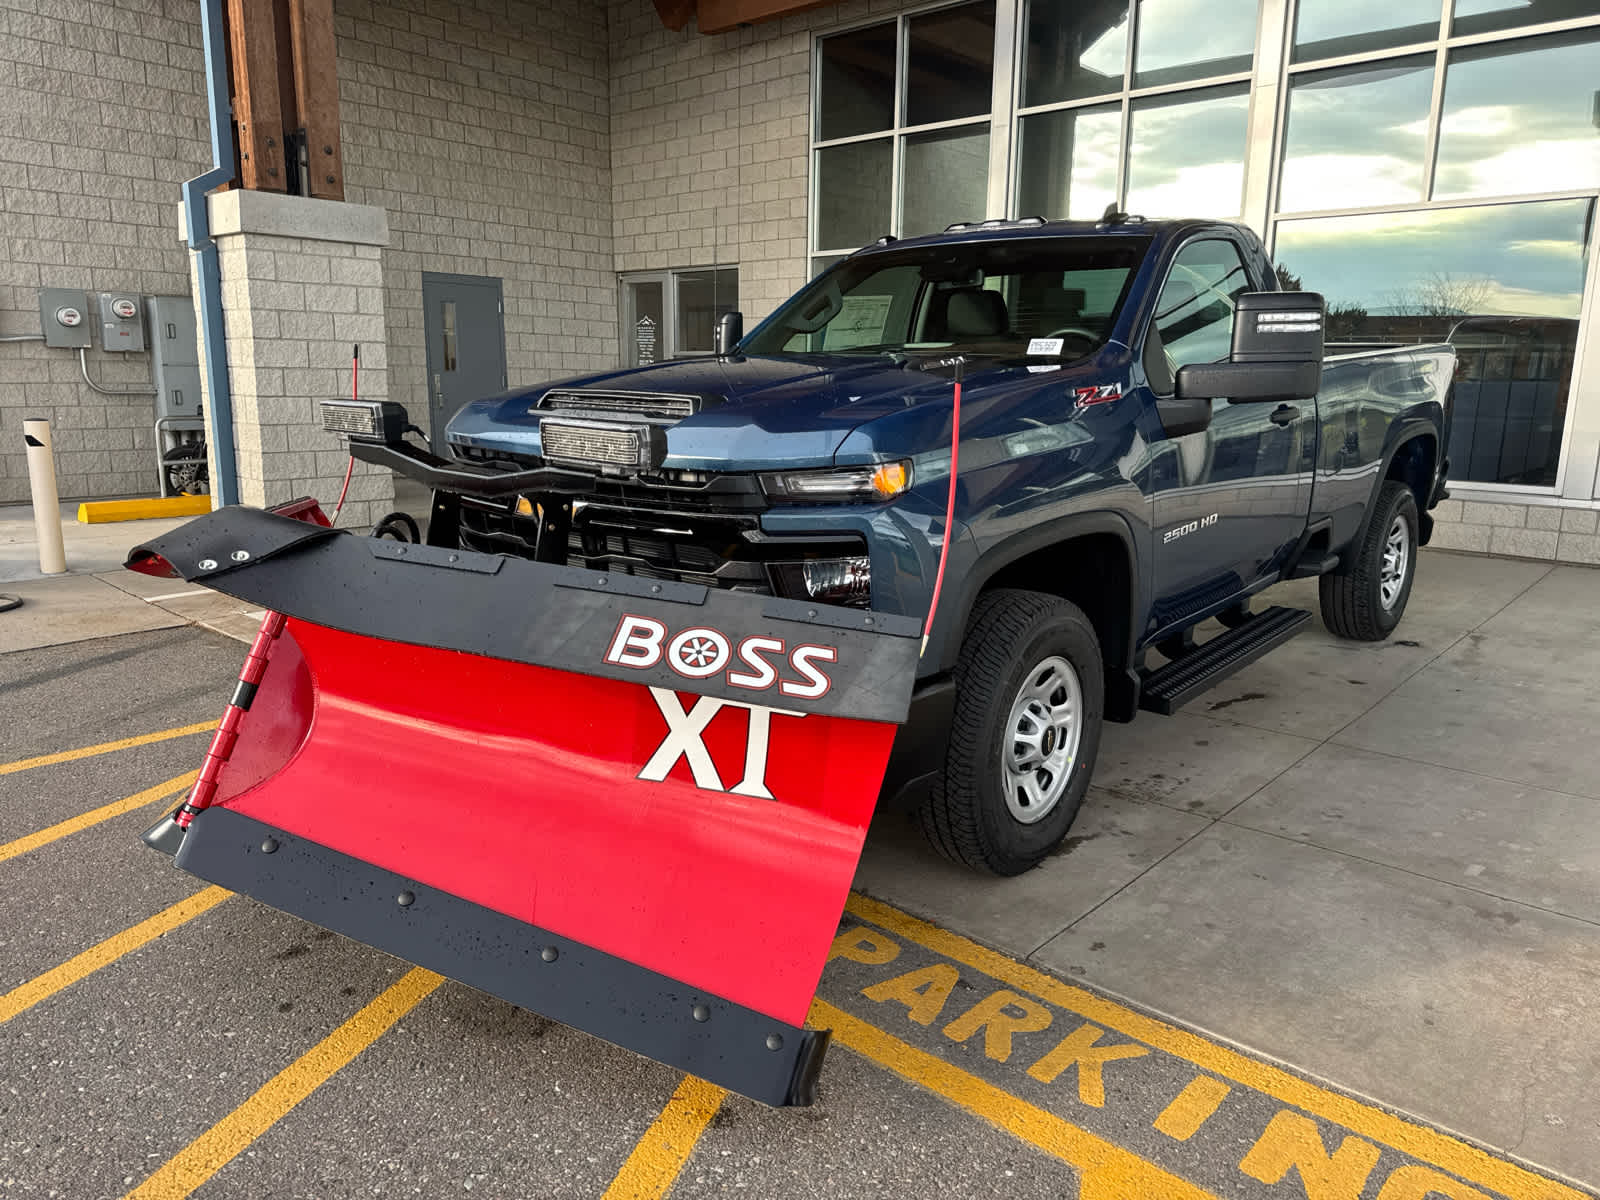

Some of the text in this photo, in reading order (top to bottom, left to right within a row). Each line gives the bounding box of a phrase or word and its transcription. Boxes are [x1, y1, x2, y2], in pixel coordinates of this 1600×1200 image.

[1072, 381, 1122, 409] Z71
[1163, 512, 1218, 545] 2500 HD
[602, 613, 838, 700] BOSS
[635, 685, 808, 801] XT
